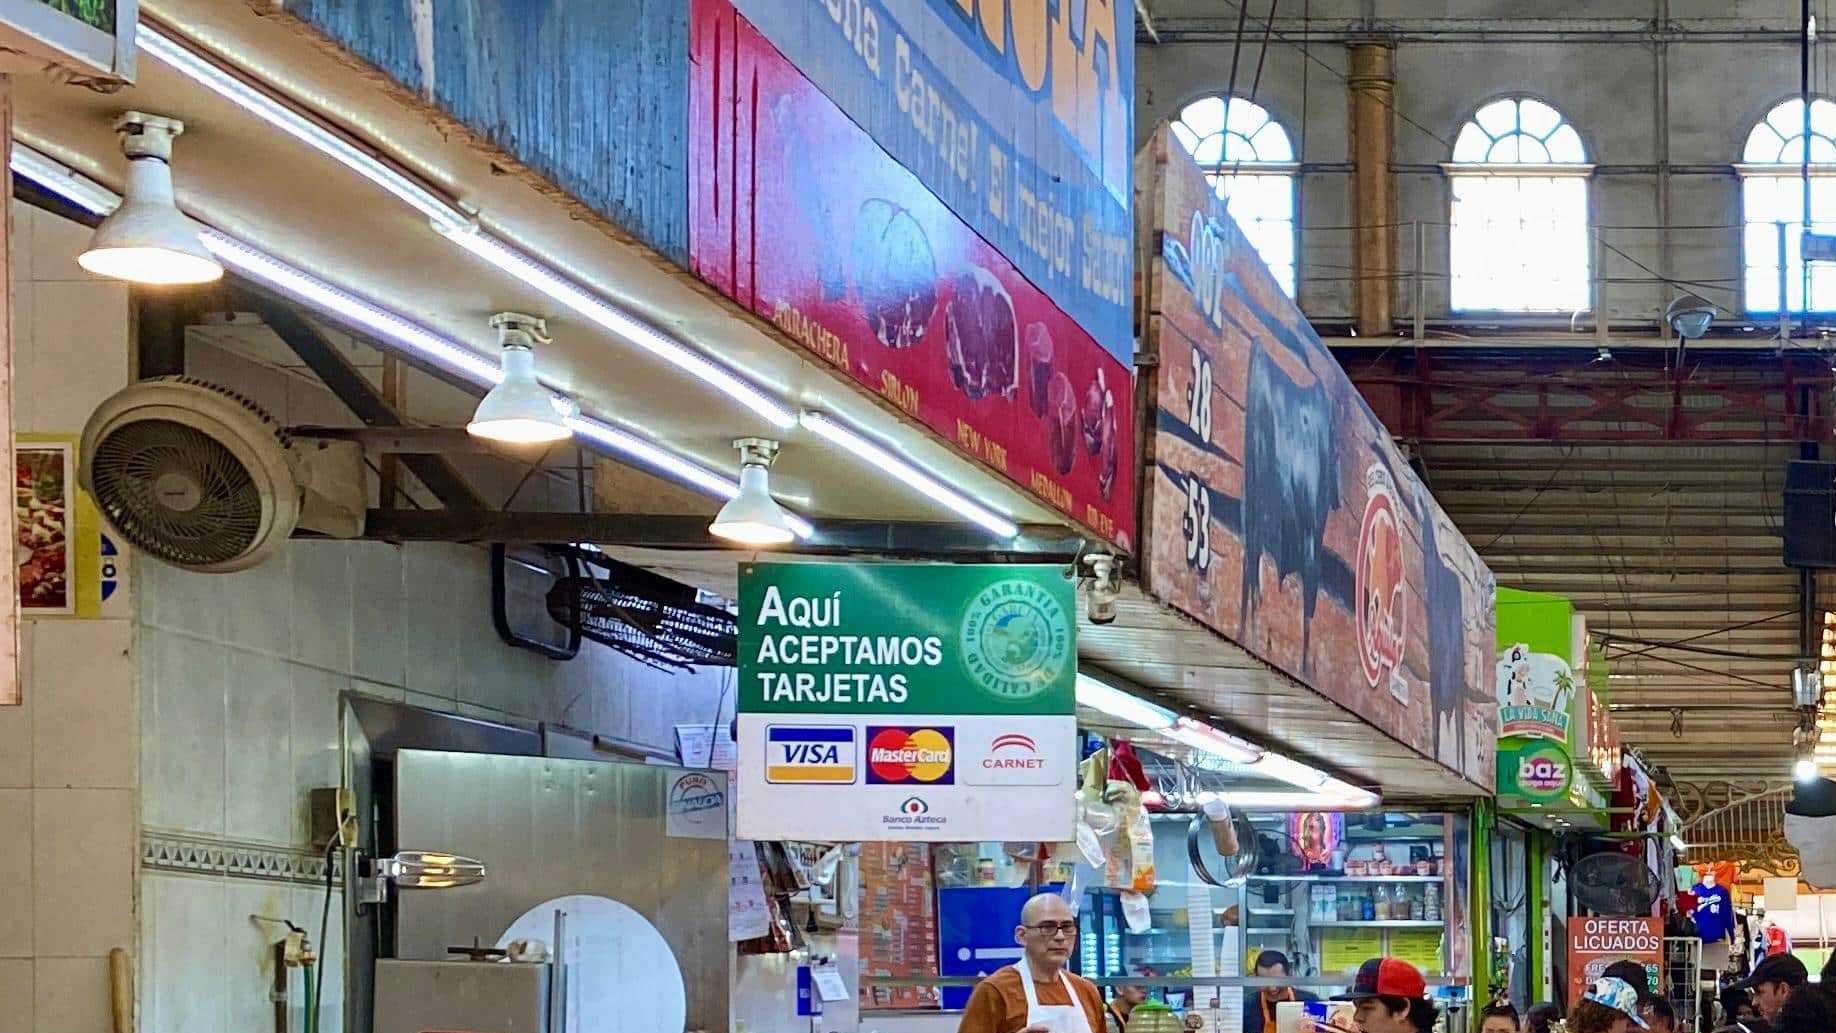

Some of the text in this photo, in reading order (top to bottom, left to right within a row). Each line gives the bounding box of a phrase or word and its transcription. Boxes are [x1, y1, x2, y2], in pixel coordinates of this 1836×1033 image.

[895, 33, 979, 193] Carne!
[772, 299, 850, 370] ARRACHERA
[955, 418, 1009, 473] NEW YORK
[757, 635, 943, 666] ACEPTAMOS
[757, 673, 909, 704] TARJETAS
[782, 743, 839, 764] VISA
[871, 747, 952, 765] MasterCard
[982, 759, 1045, 769] CARNET
[1519, 756, 1566, 780] baz
[882, 814, 948, 825] Banco Azteca
[1584, 920, 1650, 935] OFERTA
[1573, 936, 1660, 950] LICUADOS
